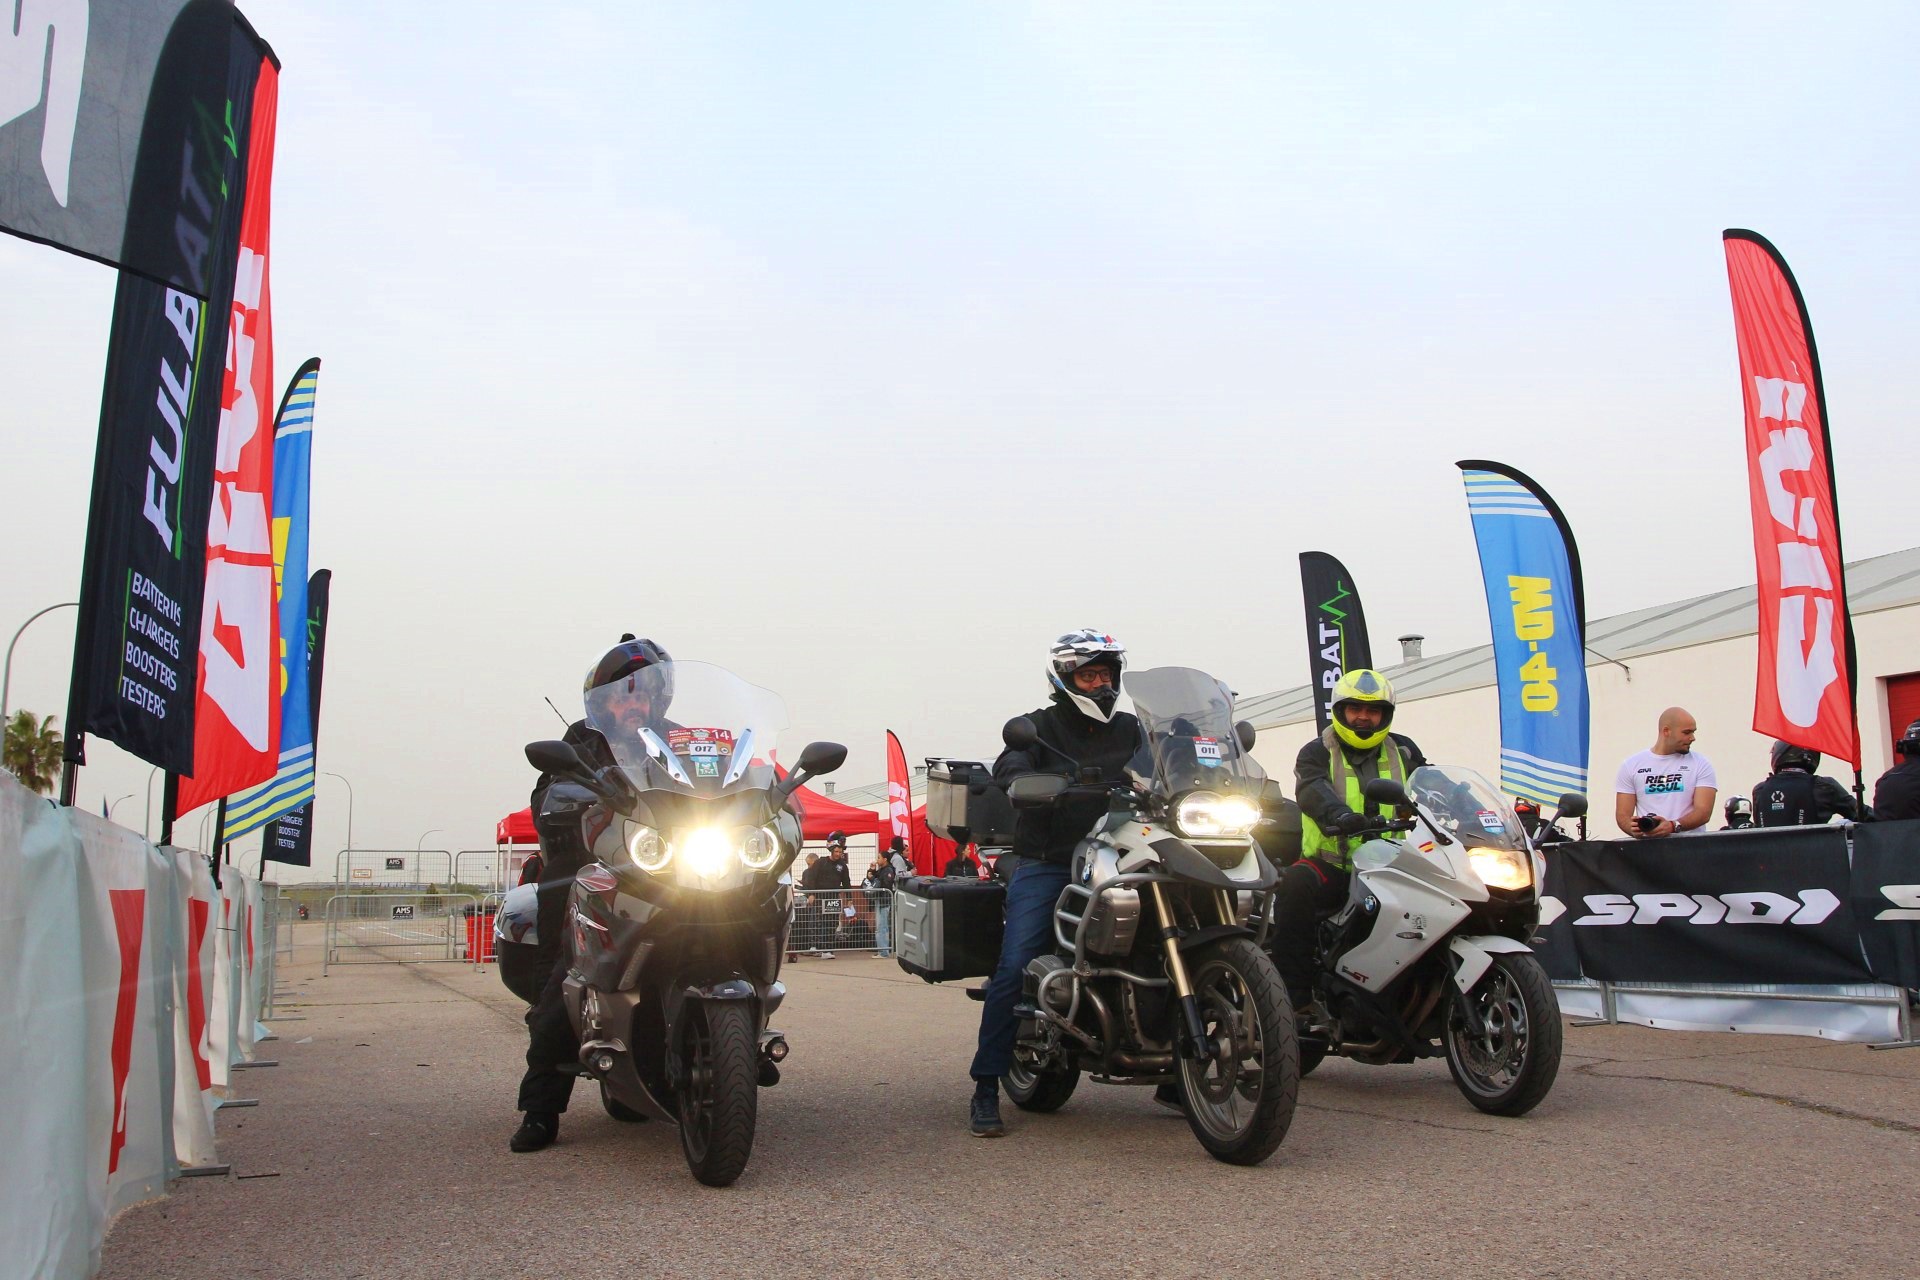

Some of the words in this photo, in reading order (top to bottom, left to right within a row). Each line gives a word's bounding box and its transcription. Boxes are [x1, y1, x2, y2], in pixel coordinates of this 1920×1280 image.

[125, 640, 177, 691] BOOSTERS
[122, 675, 166, 720] TESTERS
[694, 745, 713, 753] 017
[1645, 773, 1683, 784] RIDER
[1648, 782, 1681, 793] SOUL
[395, 906, 411, 914] AMS
[1572, 889, 1840, 926] SPIDI
